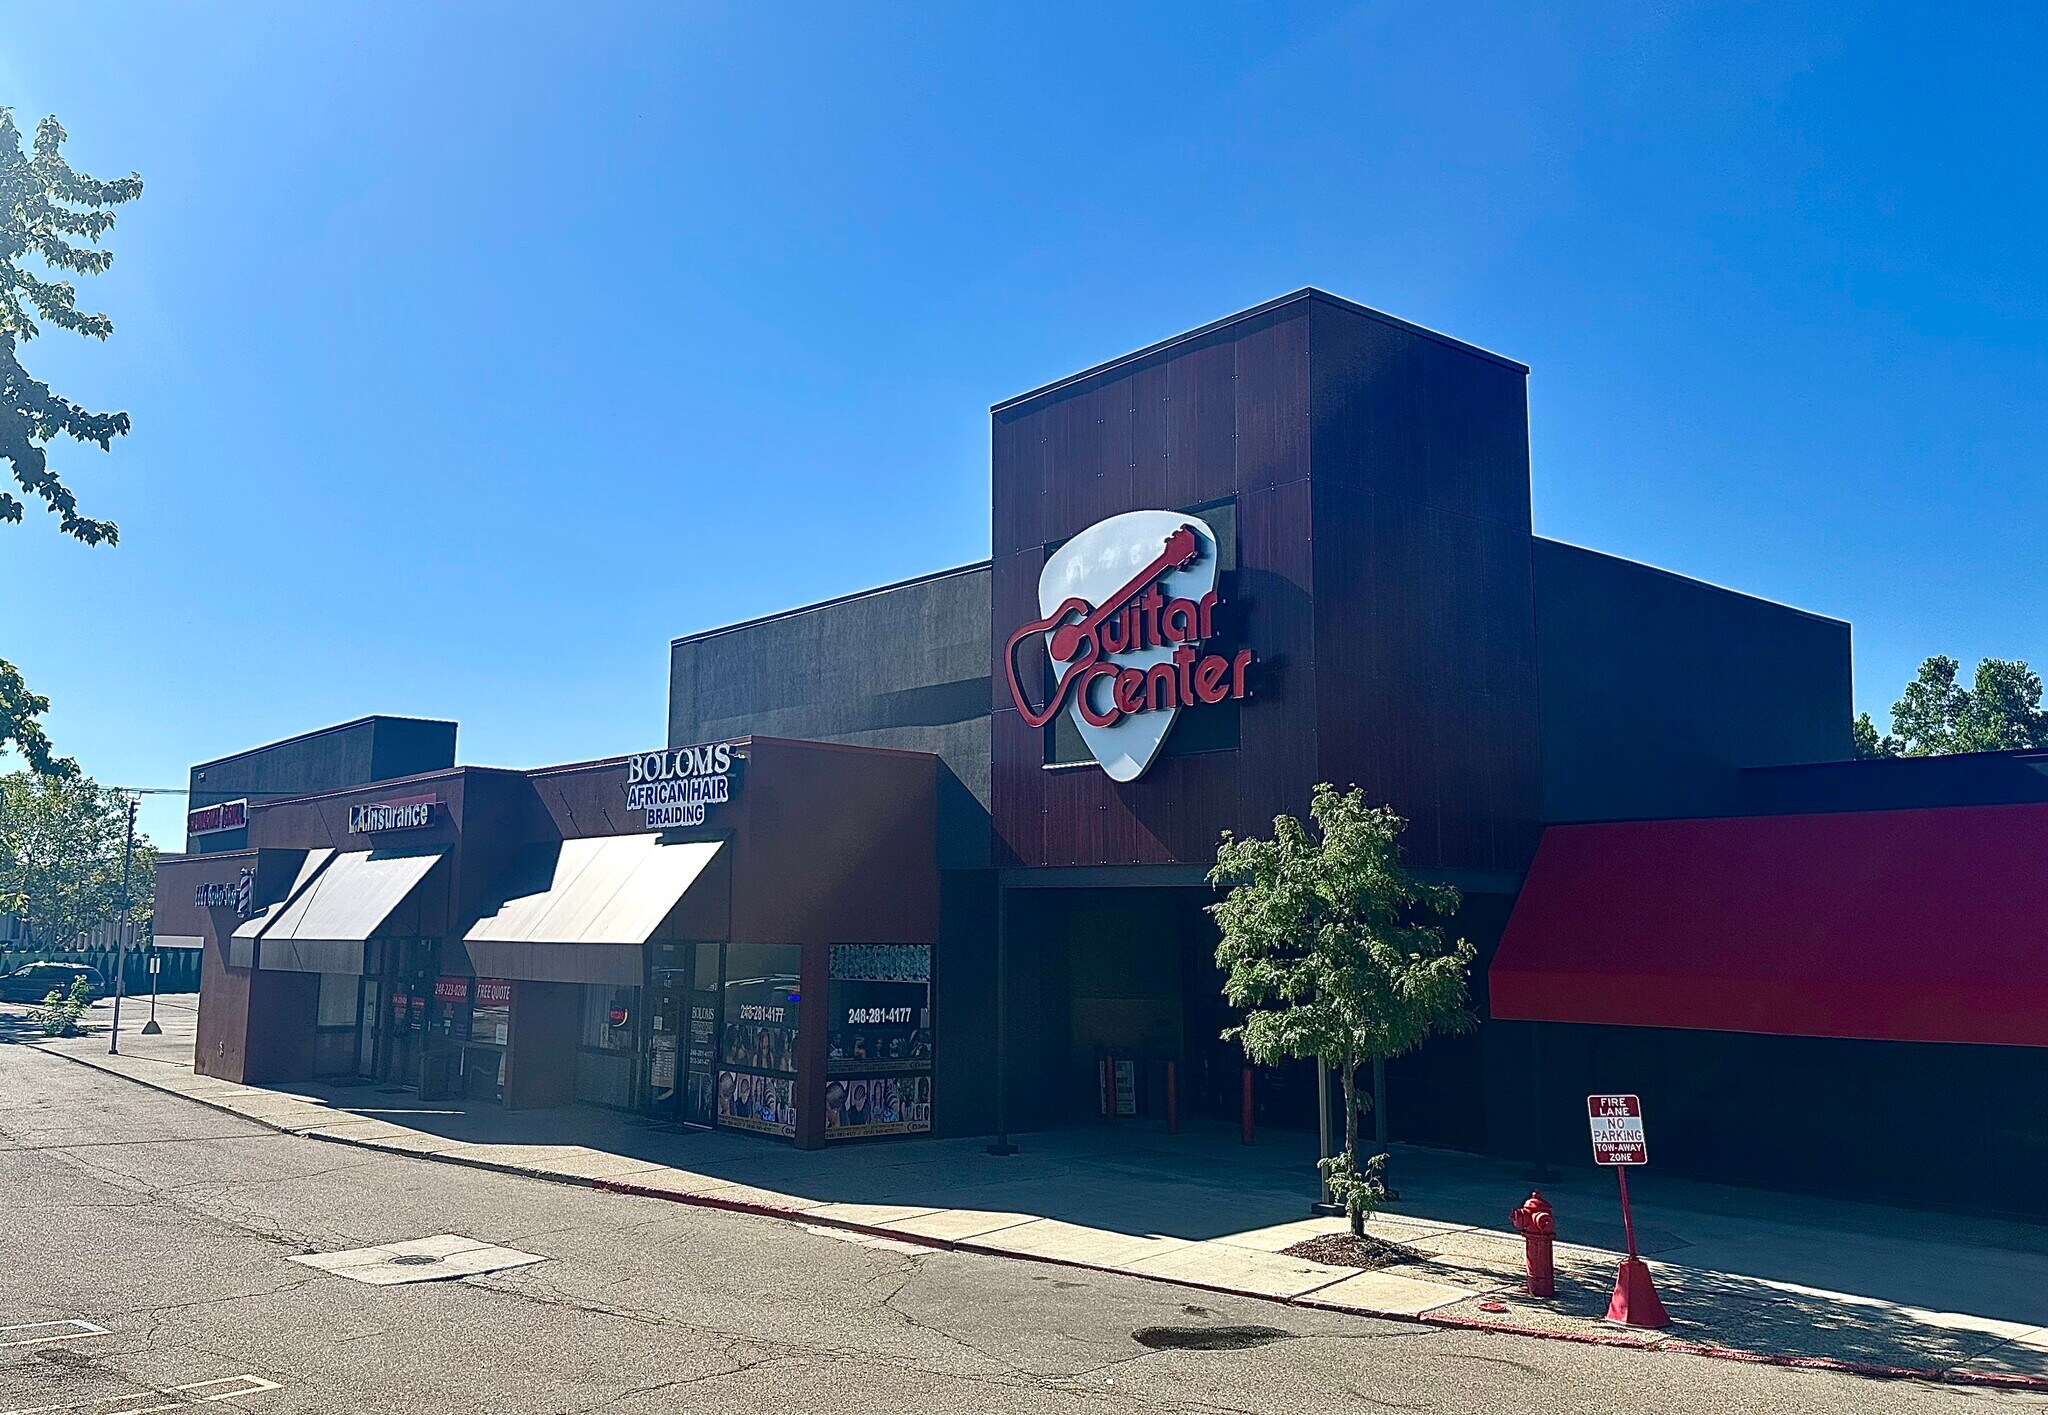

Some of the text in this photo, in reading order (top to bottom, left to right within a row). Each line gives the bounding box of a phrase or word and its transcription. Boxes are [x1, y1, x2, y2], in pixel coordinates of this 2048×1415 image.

[1077, 645, 1251, 727] Center
[627, 743, 730, 783] BOLOMS
[627, 776, 728, 809] AFRICAN HAIR
[647, 804, 704, 826] BRAIDING
[477, 984, 511, 1000] FREE QUOTE
[848, 1007, 912, 1024] 248-281-4177
[1600, 1097, 1627, 1107] FIRE
[1600, 1107, 1630, 1116] LANE
[1607, 1118, 1625, 1129] NO
[1594, 1130, 1642, 1141] PARKING
[1597, 1143, 1642, 1152] TOW-AWAY
[1609, 1153, 1633, 1162] ZONE
